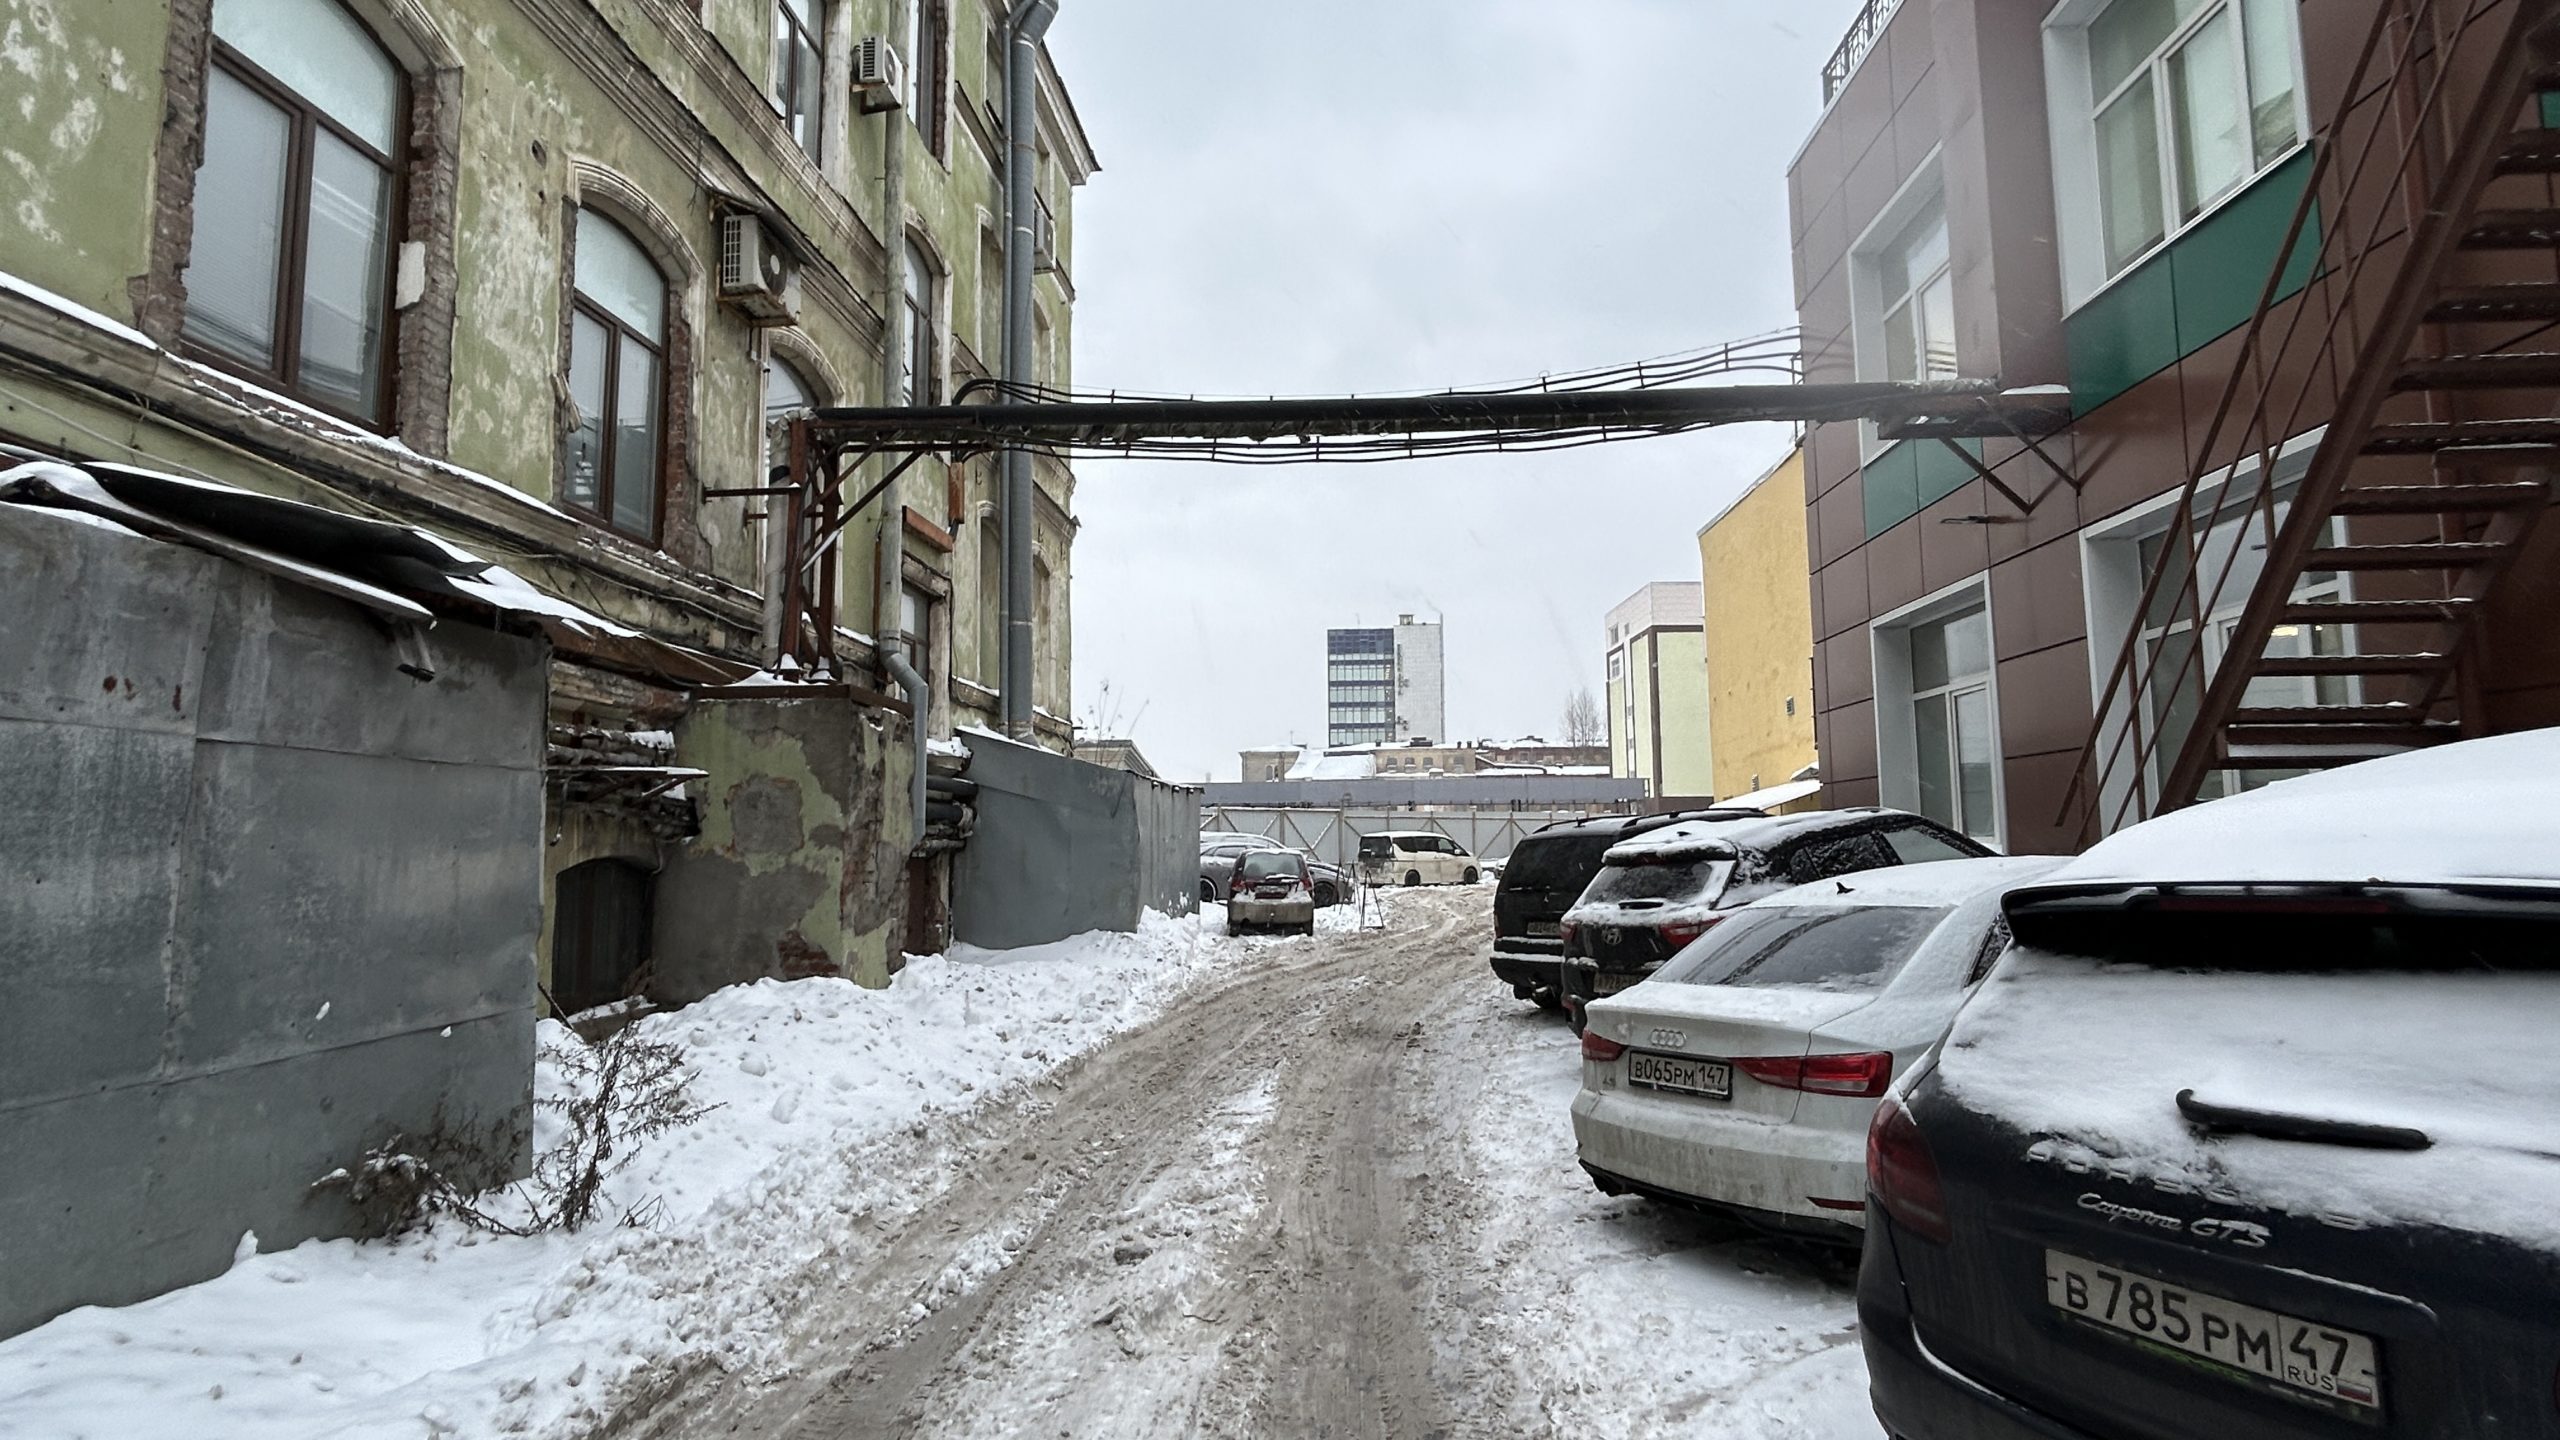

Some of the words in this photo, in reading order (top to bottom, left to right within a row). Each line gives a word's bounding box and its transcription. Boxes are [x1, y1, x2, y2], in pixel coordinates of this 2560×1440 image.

[1698, 1065, 1725, 1084] 147
[2076, 1193, 2182, 1231] Cayenne
[2190, 1217, 2272, 1248] GTS
[2289, 1327, 2349, 1377] 47
[2287, 1364, 2335, 1392] RUS
